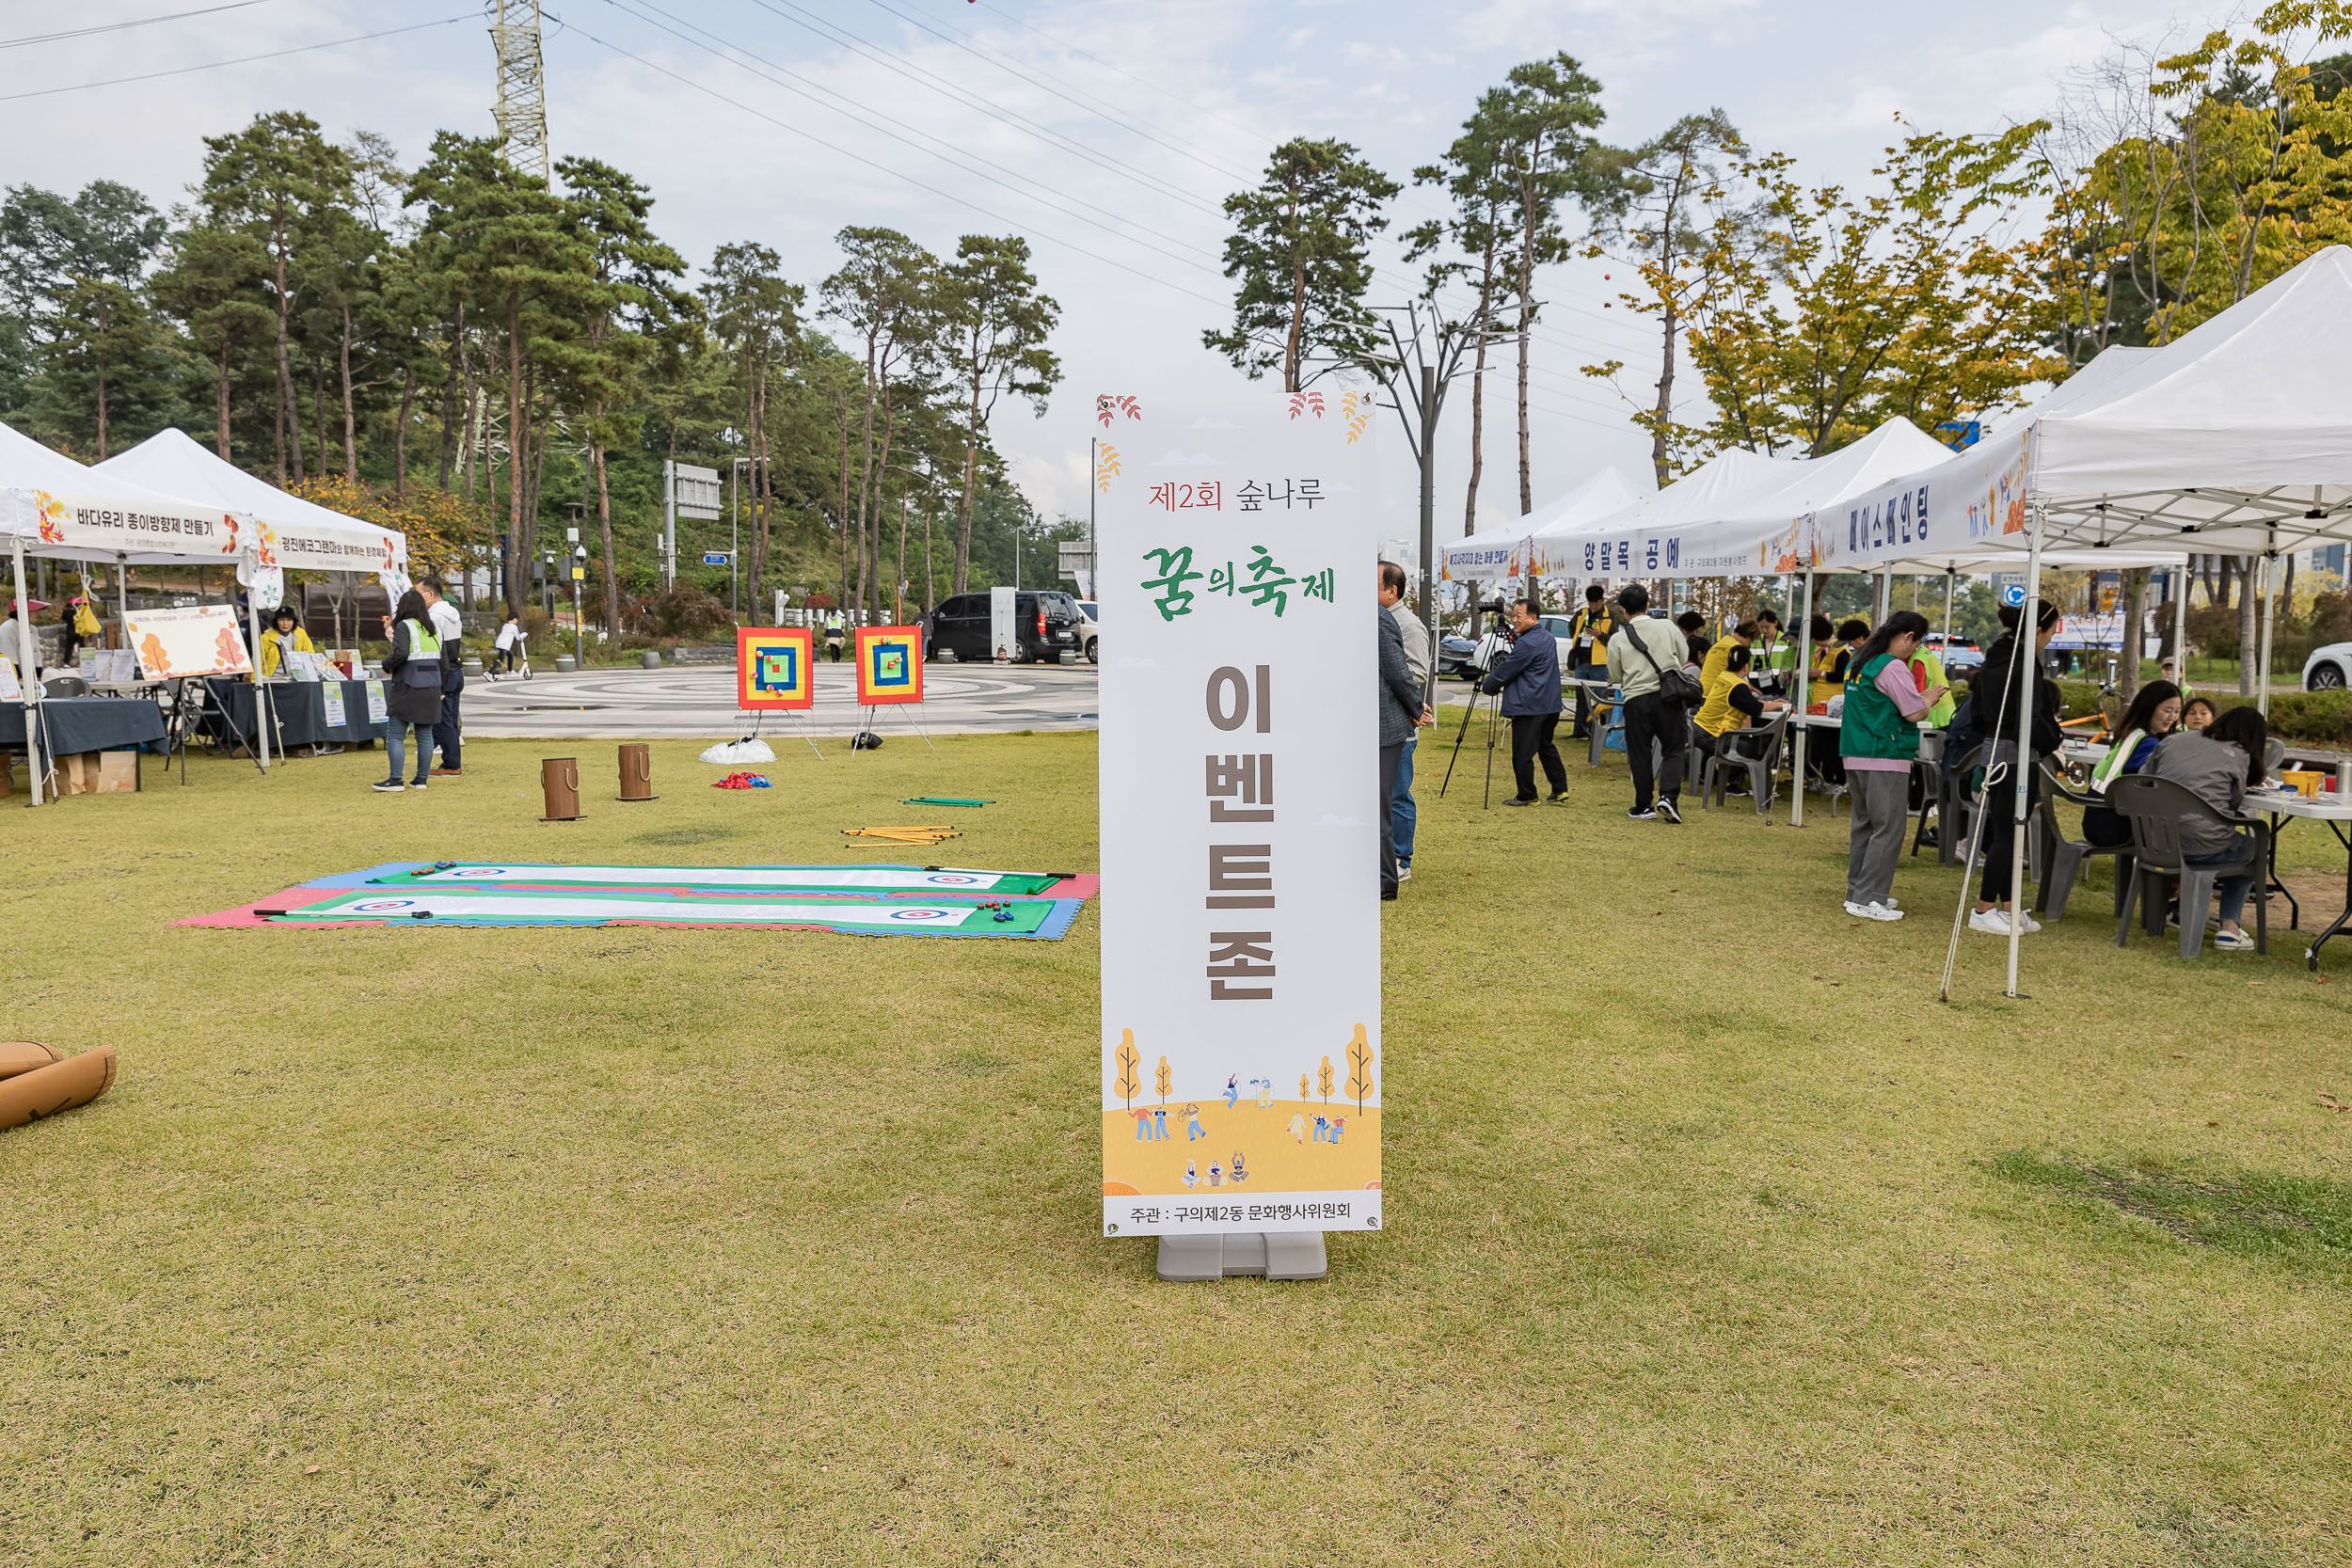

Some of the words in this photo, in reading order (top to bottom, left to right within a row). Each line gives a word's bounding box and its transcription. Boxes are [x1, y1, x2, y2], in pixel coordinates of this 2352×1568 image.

[1149, 481, 1221, 512] 제2회
[1236, 478, 1326, 512] 숲나루
[77, 508, 123, 529] 바다유리
[127, 513, 181, 533] 종이방향제
[183, 518, 214, 537] 만들기
[1850, 484, 1929, 553] 페이스페인팅
[1584, 541, 1629, 571] 양말목
[1646, 536, 1680, 571] 공예
[1205, 664, 1276, 1000] 이벤트존
[1130, 1207, 1161, 1224] 주관
[1173, 1205, 1245, 1223] 구의제2동
[1248, 1202, 1351, 1221] 문화행사위원회
